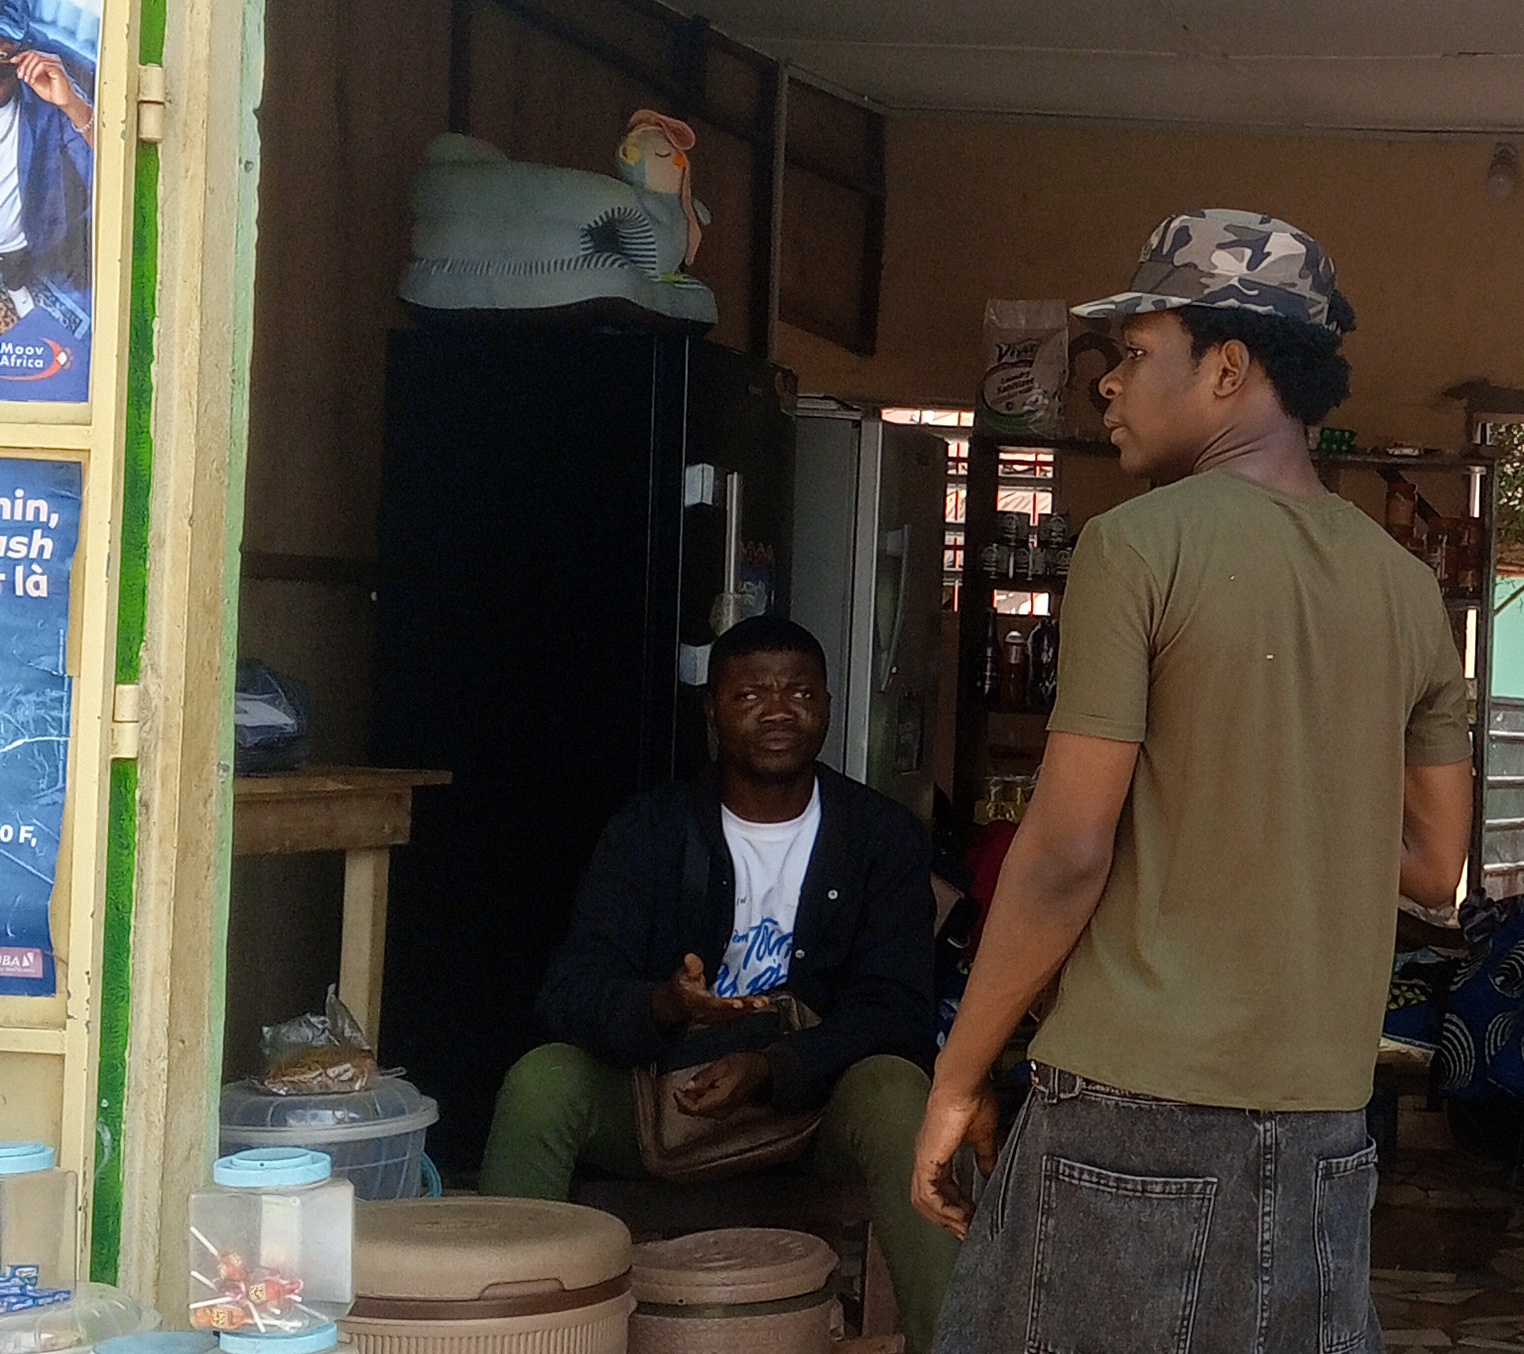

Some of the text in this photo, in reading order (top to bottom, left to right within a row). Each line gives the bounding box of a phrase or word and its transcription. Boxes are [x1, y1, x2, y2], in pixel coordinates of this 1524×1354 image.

[0, 342, 44, 356] Moov
[0, 354, 44, 368] Africa
[15, 563, 48, 598] là
